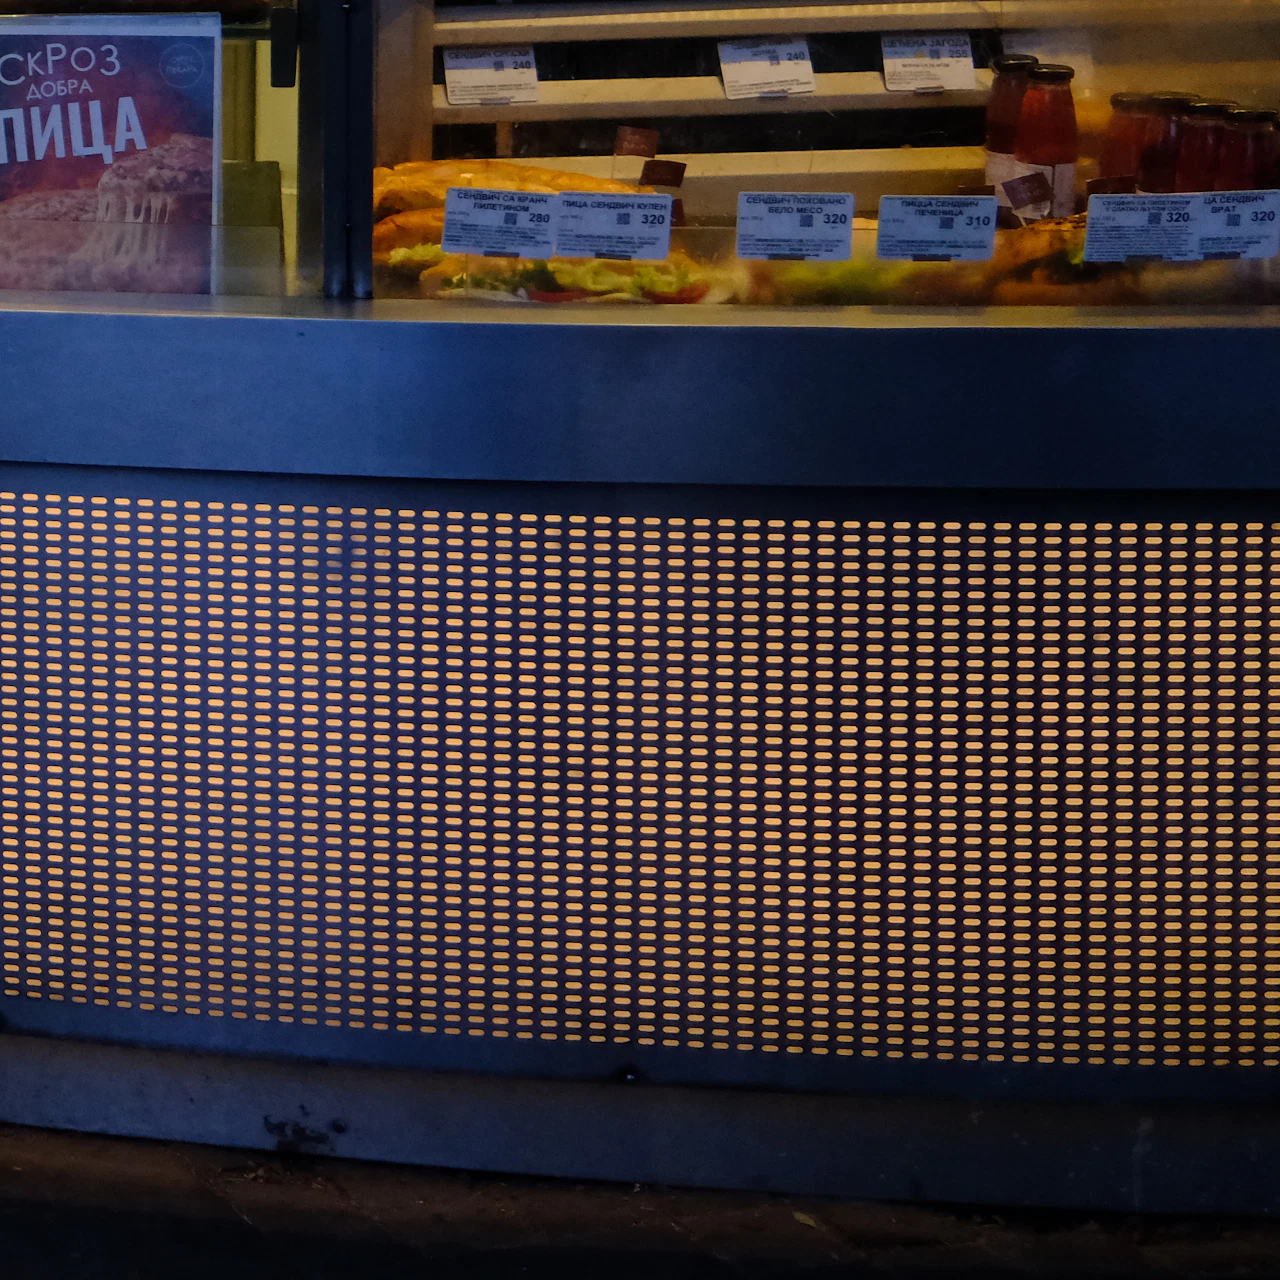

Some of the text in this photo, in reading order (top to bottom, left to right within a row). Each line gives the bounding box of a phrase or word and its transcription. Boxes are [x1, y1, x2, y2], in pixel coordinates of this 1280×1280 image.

[883, 38, 969, 48] ЦЕЂЕНА ЈАГОДА
[786, 51, 806, 61] 240
[948, 49, 968, 59] 255
[512, 60, 531, 69] 240
[26, 79, 94, 101] ДОБРА
[456, 191, 548, 204] СЕНДВИЧ СА КРАНЧ
[746, 196, 846, 205] СЕНДВИЧ ПОХОВАНО
[1219, 195, 1266, 204] СЕНДВИЧ
[473, 202, 530, 212] ПИЛЕТИНОМ
[562, 199, 667, 211] ПИЦА СЕНДВИЧ КУЛЕН
[935, 200, 979, 208] СЕНДВИЧ
[768, 206, 823, 214] БЕЛО МЕСО
[914, 209, 964, 217] ПЕЧЕНИЦА
[1210, 205, 1237, 214] ВРАТ
[528, 213, 551, 223] 280
[641, 214, 666, 225] 320
[823, 213, 847, 224] 320
[965, 216, 991, 226] 310
[1166, 212, 1190, 223] 320
[1251, 211, 1276, 222] 320
